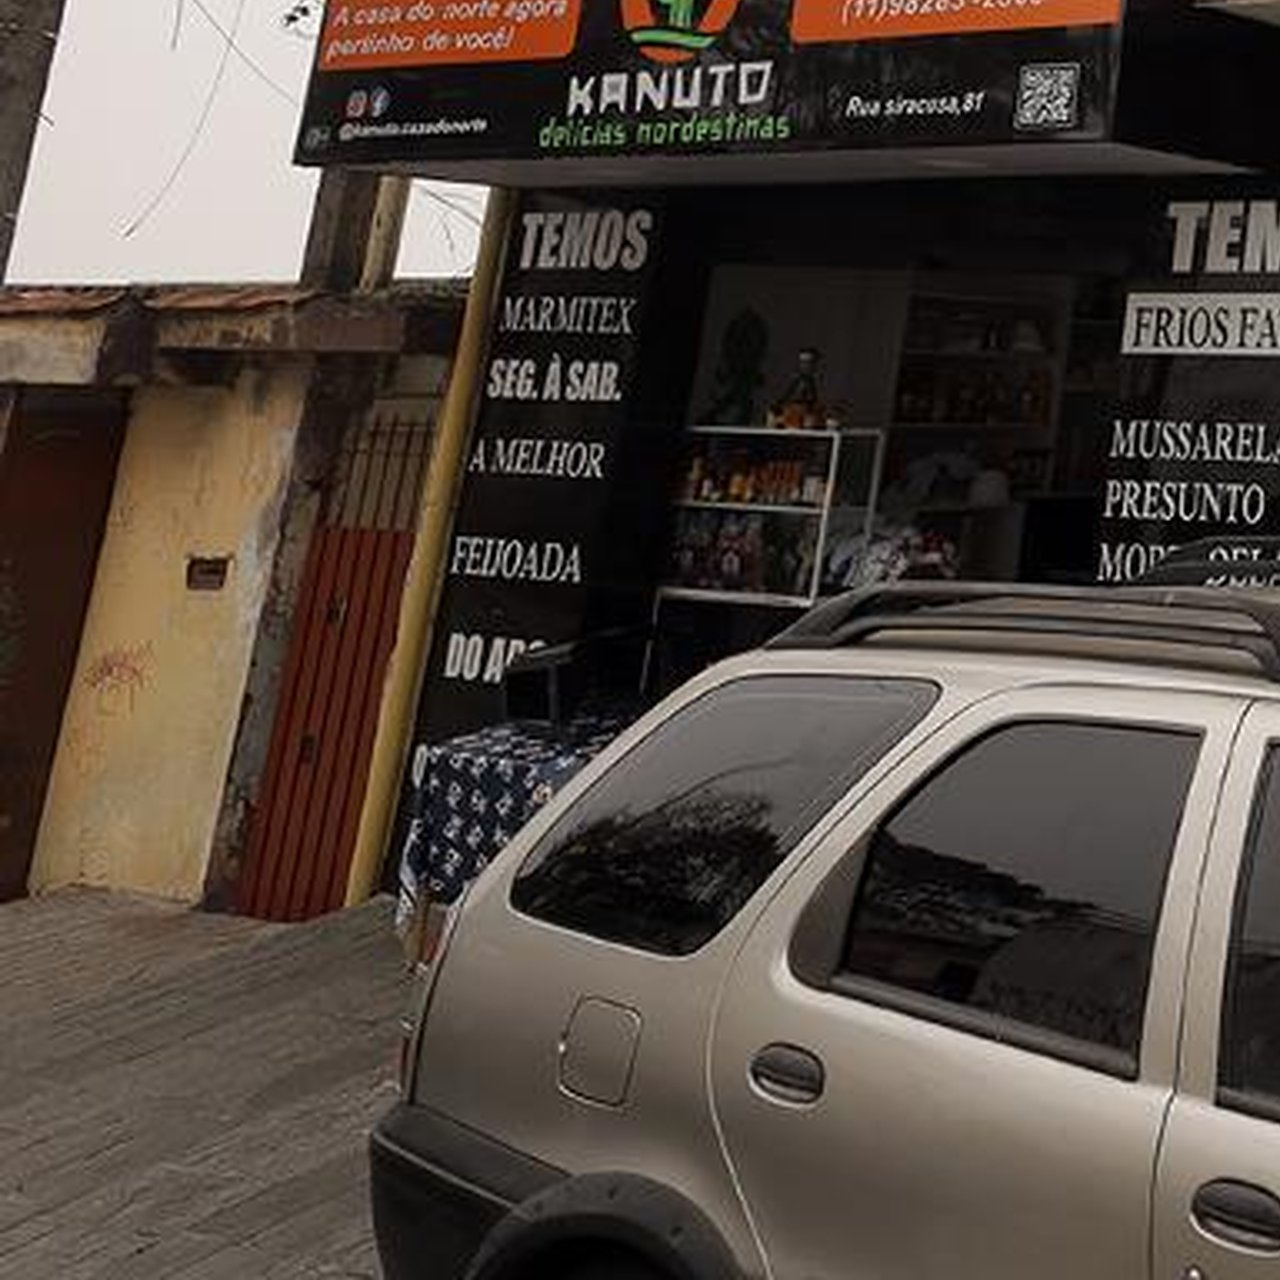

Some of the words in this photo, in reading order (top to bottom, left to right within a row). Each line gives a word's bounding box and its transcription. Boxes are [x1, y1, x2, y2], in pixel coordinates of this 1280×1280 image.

[332, 6, 350, 28] A
[353, 2, 400, 25] casa
[405, 0, 436, 21] do
[441, 0, 500, 21] norte
[325, 33, 414, 64] pertinho
[422, 31, 447, 52] de
[566, 60, 774, 117] KANUTO
[845, 96, 881, 118] Rua
[636, 111, 792, 145] nordestinas
[518, 209, 654, 271] TEMOS
[499, 295, 639, 335] MARMITEX
[1132, 306, 1230, 349] FRIOS
[486, 359, 539, 401] SEG.
[541, 351, 563, 402] À
[564, 361, 623, 403] SAB.
[467, 437, 488, 473] A
[492, 437, 605, 479] MELHOR
[1102, 479, 1266, 526] PRESUNTO
[450, 534, 582, 583] FEIJOADA
[444, 631, 485, 682] DO
